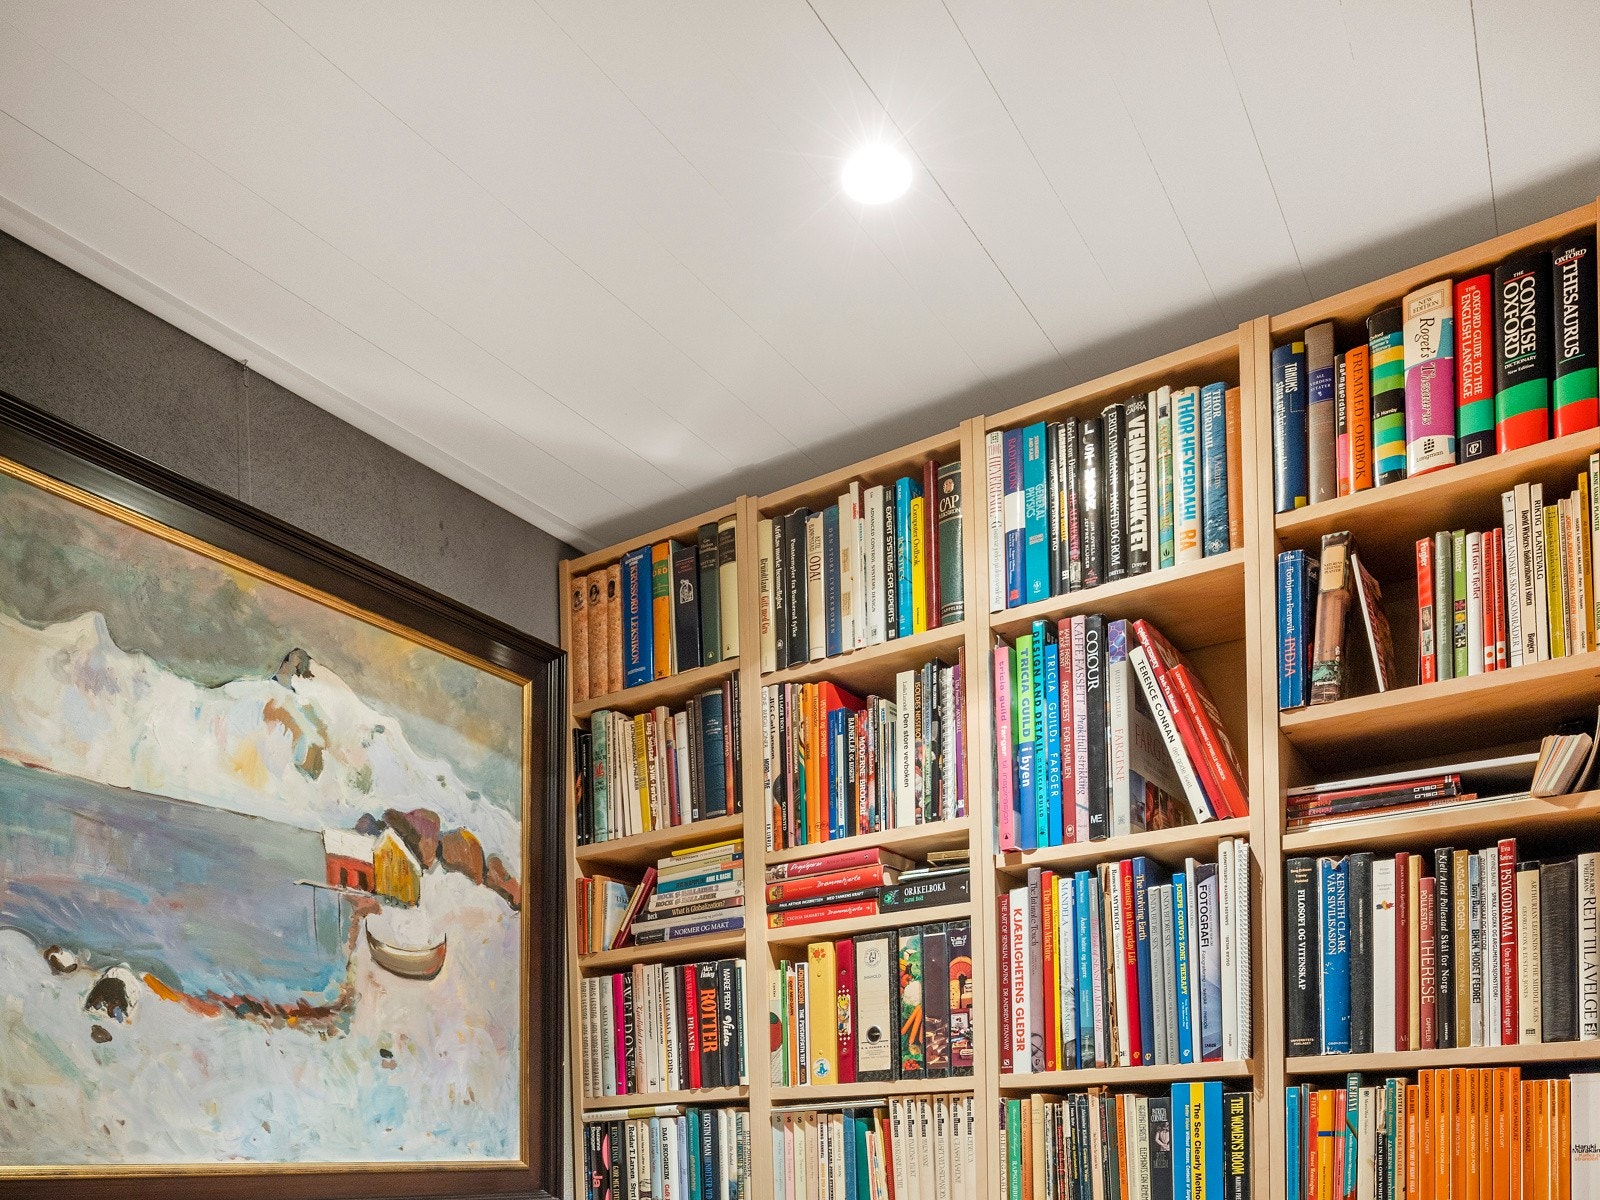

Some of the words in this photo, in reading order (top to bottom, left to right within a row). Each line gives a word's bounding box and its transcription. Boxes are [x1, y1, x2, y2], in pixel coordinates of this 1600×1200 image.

[1555, 248, 1586, 265] OXFORD
[1461, 294, 1471, 340] ENGLISH
[1472, 290, 1480, 328] OXFORD
[1503, 282, 1518, 359] OXFORD
[1520, 276, 1536, 353] CONCISE
[1563, 260, 1579, 357] THESAURUS
[1415, 317, 1436, 358] Roget's
[1473, 330, 1481, 359] GUIDE
[1285, 363, 1297, 393] TANUMS
[1462, 342, 1473, 398] LANGUAGE
[1474, 361, 1482, 373] TO
[1504, 355, 1536, 369] DICTIONARY
[1353, 352, 1364, 416] FREMMED
[1422, 362, 1435, 425] Thesaurus
[1474, 375, 1483, 395] THE
[1213, 389, 1221, 417] THOR
[1203, 393, 1213, 450] HEYERDAHL
[1355, 425, 1366, 480] ORDBOK
[1416, 450, 1444, 463] Longman
[1128, 414, 1147, 552] VENDEPUNKTET
[1026, 486, 1035, 518] PHYSICS
[1035, 484, 1045, 520] GENERAL
[912, 504, 920, 538] Computer
[1419, 542, 1428, 567] Fugler
[1454, 536, 1464, 573] Blomster
[1506, 523, 1517, 577] ØSTLANDSKE
[1535, 530, 1543, 580] PLANTEVALG
[810, 556, 820, 582] ODA!
[630, 567, 638, 614] KRYSSORD
[775, 568, 783, 609] hemmelighet
[1510, 579, 1521, 647] SKOGSOMRÅDER
[1021, 649, 1029, 693] TRICIA
[1048, 655, 1056, 692] TRICIA
[1087, 630, 1098, 692] COLOUR
[1284, 638, 1296, 677] INDIA
[1022, 698, 1030, 737] GUILD
[1136, 660, 1158, 702] TERENCE
[1154, 703, 1176, 744] CONRAN
[1048, 703, 1057, 743] GUILDs
[1020, 756, 1032, 787] byen
[1439, 855, 1448, 874] Kjell
[1044, 889, 1052, 900] The
[1327, 873, 1338, 893] VÅR
[1337, 873, 1346, 917] KENNETH
[1440, 876, 1448, 895] Arild
[672, 908, 685, 916] What
[691, 900, 725, 913] Globalization?
[1044, 902, 1052, 931] Human
[1136, 890, 1145, 920] Evolving
[1198, 885, 1209, 947] FOTOGRAFI
[1297, 889, 1306, 926] FILOSOFI
[1420, 890, 1428, 931] POLLESTAD
[1440, 898, 1449, 931] Pollestad
[1501, 869, 1513, 937] PSYKODRAMA
[675, 927, 699, 936] NORMER
[711, 922, 729, 930] MAKT
[1138, 922, 1146, 940] Earth
[1298, 929, 1306, 939] OG
[1328, 896, 1337, 955] SIVILISASJON
[1337, 919, 1346, 953] CLARK
[1441, 934, 1450, 952] Skål
[1014, 909, 1024, 1002] KJÆRLIGHETENS
[1044, 933, 1053, 961] Machine
[1441, 955, 1449, 964] for
[1298, 942, 1306, 990] VITENSKAP
[1422, 937, 1434, 1004] THERESE
[1440, 970, 1450, 994] Norge
[700, 989, 717, 1052] RØTTER
[723, 1016, 734, 1046] Vida
[1231, 1098, 1244, 1113] THE
[1231, 1115, 1244, 1150] WOMEN'S
[1193, 1142, 1202, 1170] Clearly
[1232, 1152, 1245, 1175] ROOM
[593, 1171, 602, 1188] Ja
